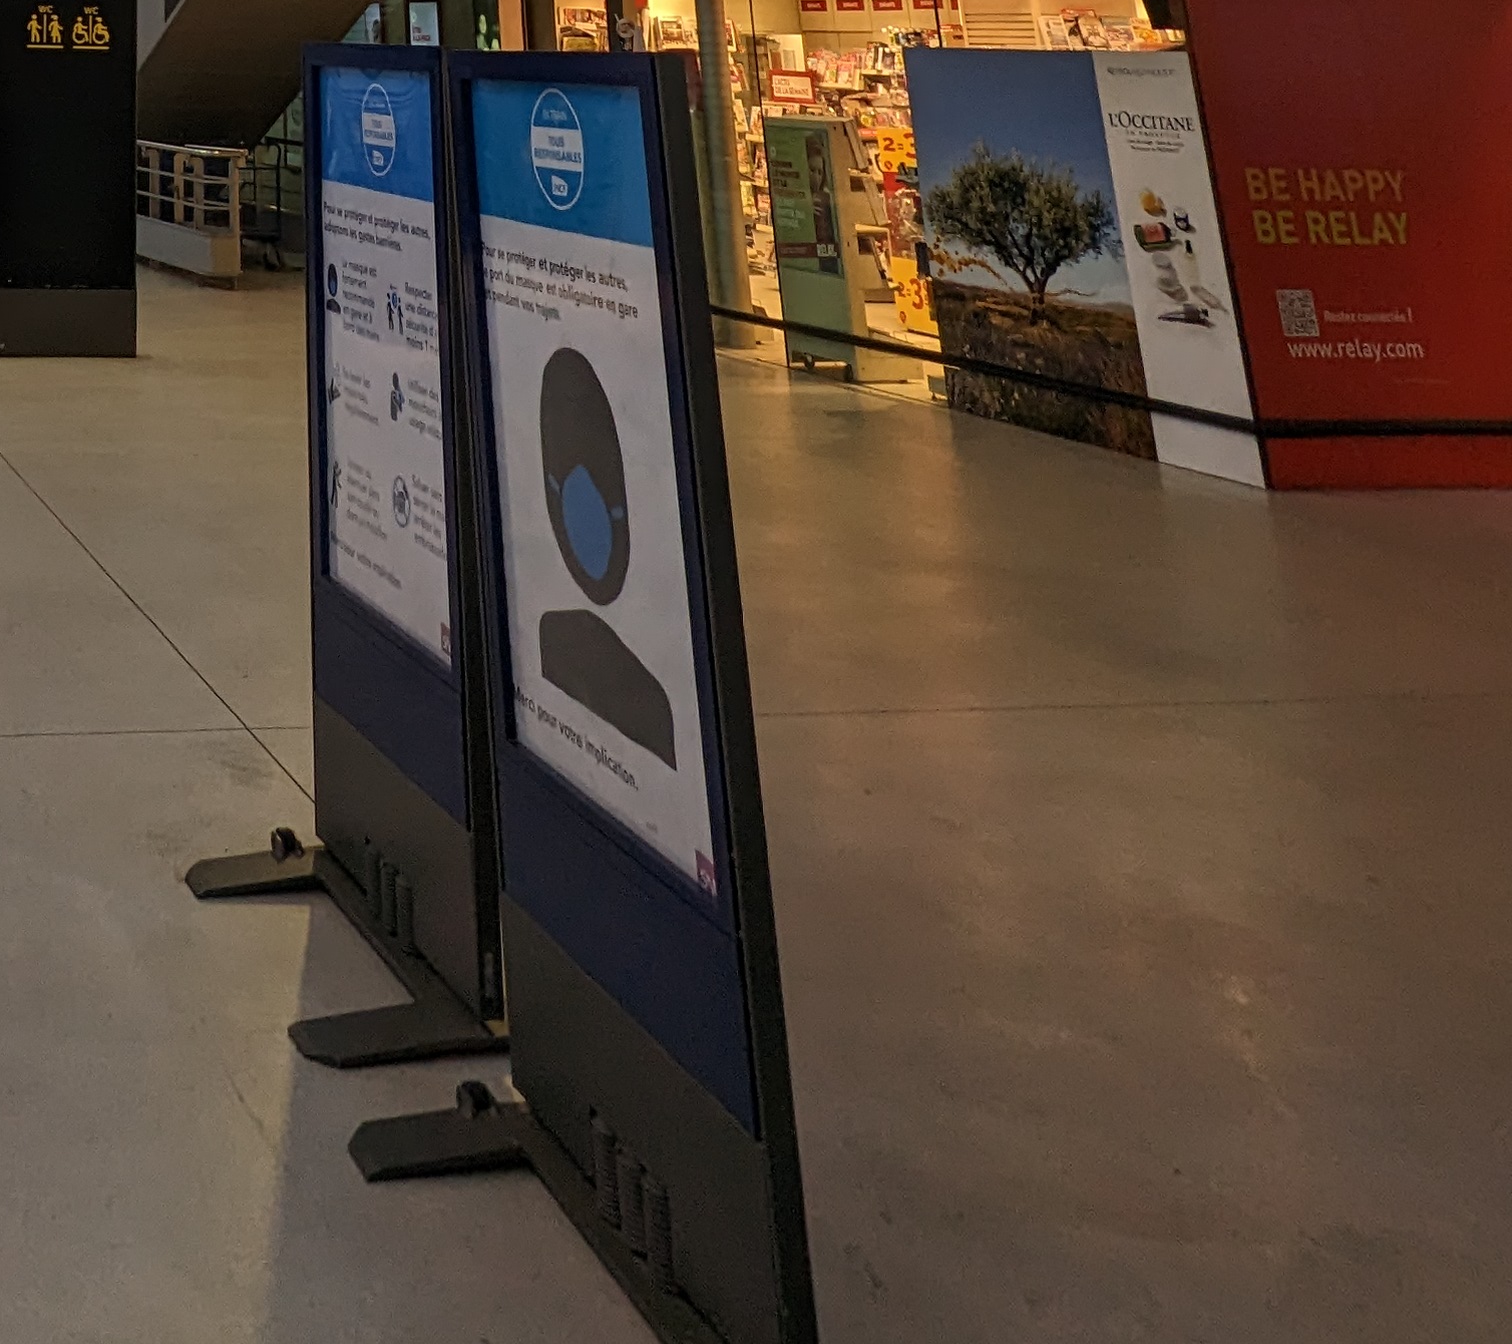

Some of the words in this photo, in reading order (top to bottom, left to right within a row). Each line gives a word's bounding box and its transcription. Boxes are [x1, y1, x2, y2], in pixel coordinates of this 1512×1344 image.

[38, 5, 54, 14] WC
[83, 6, 99, 15] WC
[1108, 110, 1196, 132] L'OCCITANE
[1245, 167, 1290, 201] BE
[1297, 167, 1408, 202] HAPPY
[1252, 210, 1300, 245] BE
[1305, 210, 1408, 246] RELAY
[548, 258, 584, 282] protéger
[598, 272, 629, 292] autres,
[618, 302, 638, 319] gare
[1287, 339, 1425, 362] www.relay.com
